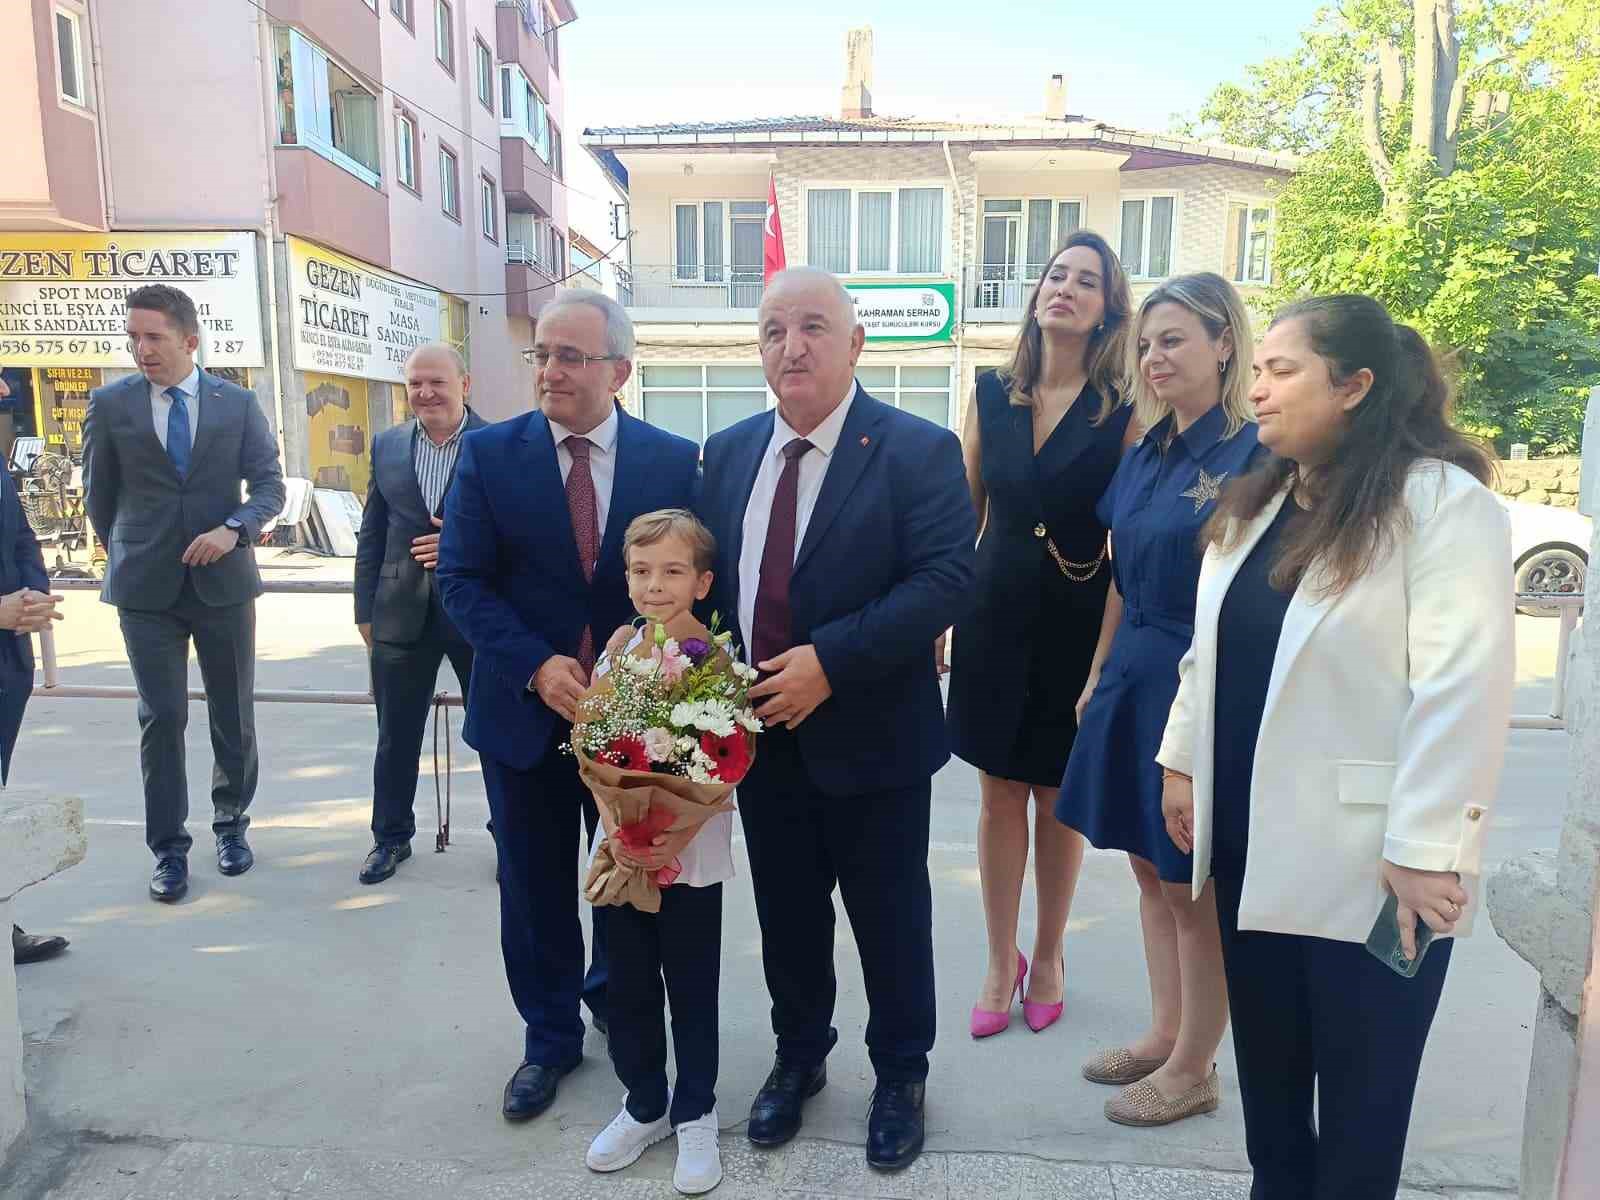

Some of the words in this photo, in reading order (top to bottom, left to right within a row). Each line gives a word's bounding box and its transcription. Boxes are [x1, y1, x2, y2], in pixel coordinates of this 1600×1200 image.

[84, 243, 239, 277] TİCARET
[306, 258, 361, 298] GEZEN
[39, 287, 80, 300] SPOT
[44, 304, 62, 315] EL
[67, 303, 106, 319] EŞYA
[300, 293, 369, 338] TİCARET
[857, 308, 905, 318] KAHRAMAN
[906, 308, 941, 318] SERHAD
[390, 311, 420, 331] MASA
[36, 341, 63, 354] 575
[69, 341, 87, 354] 67
[94, 341, 111, 355] 19
[225, 340, 244, 353] 87
